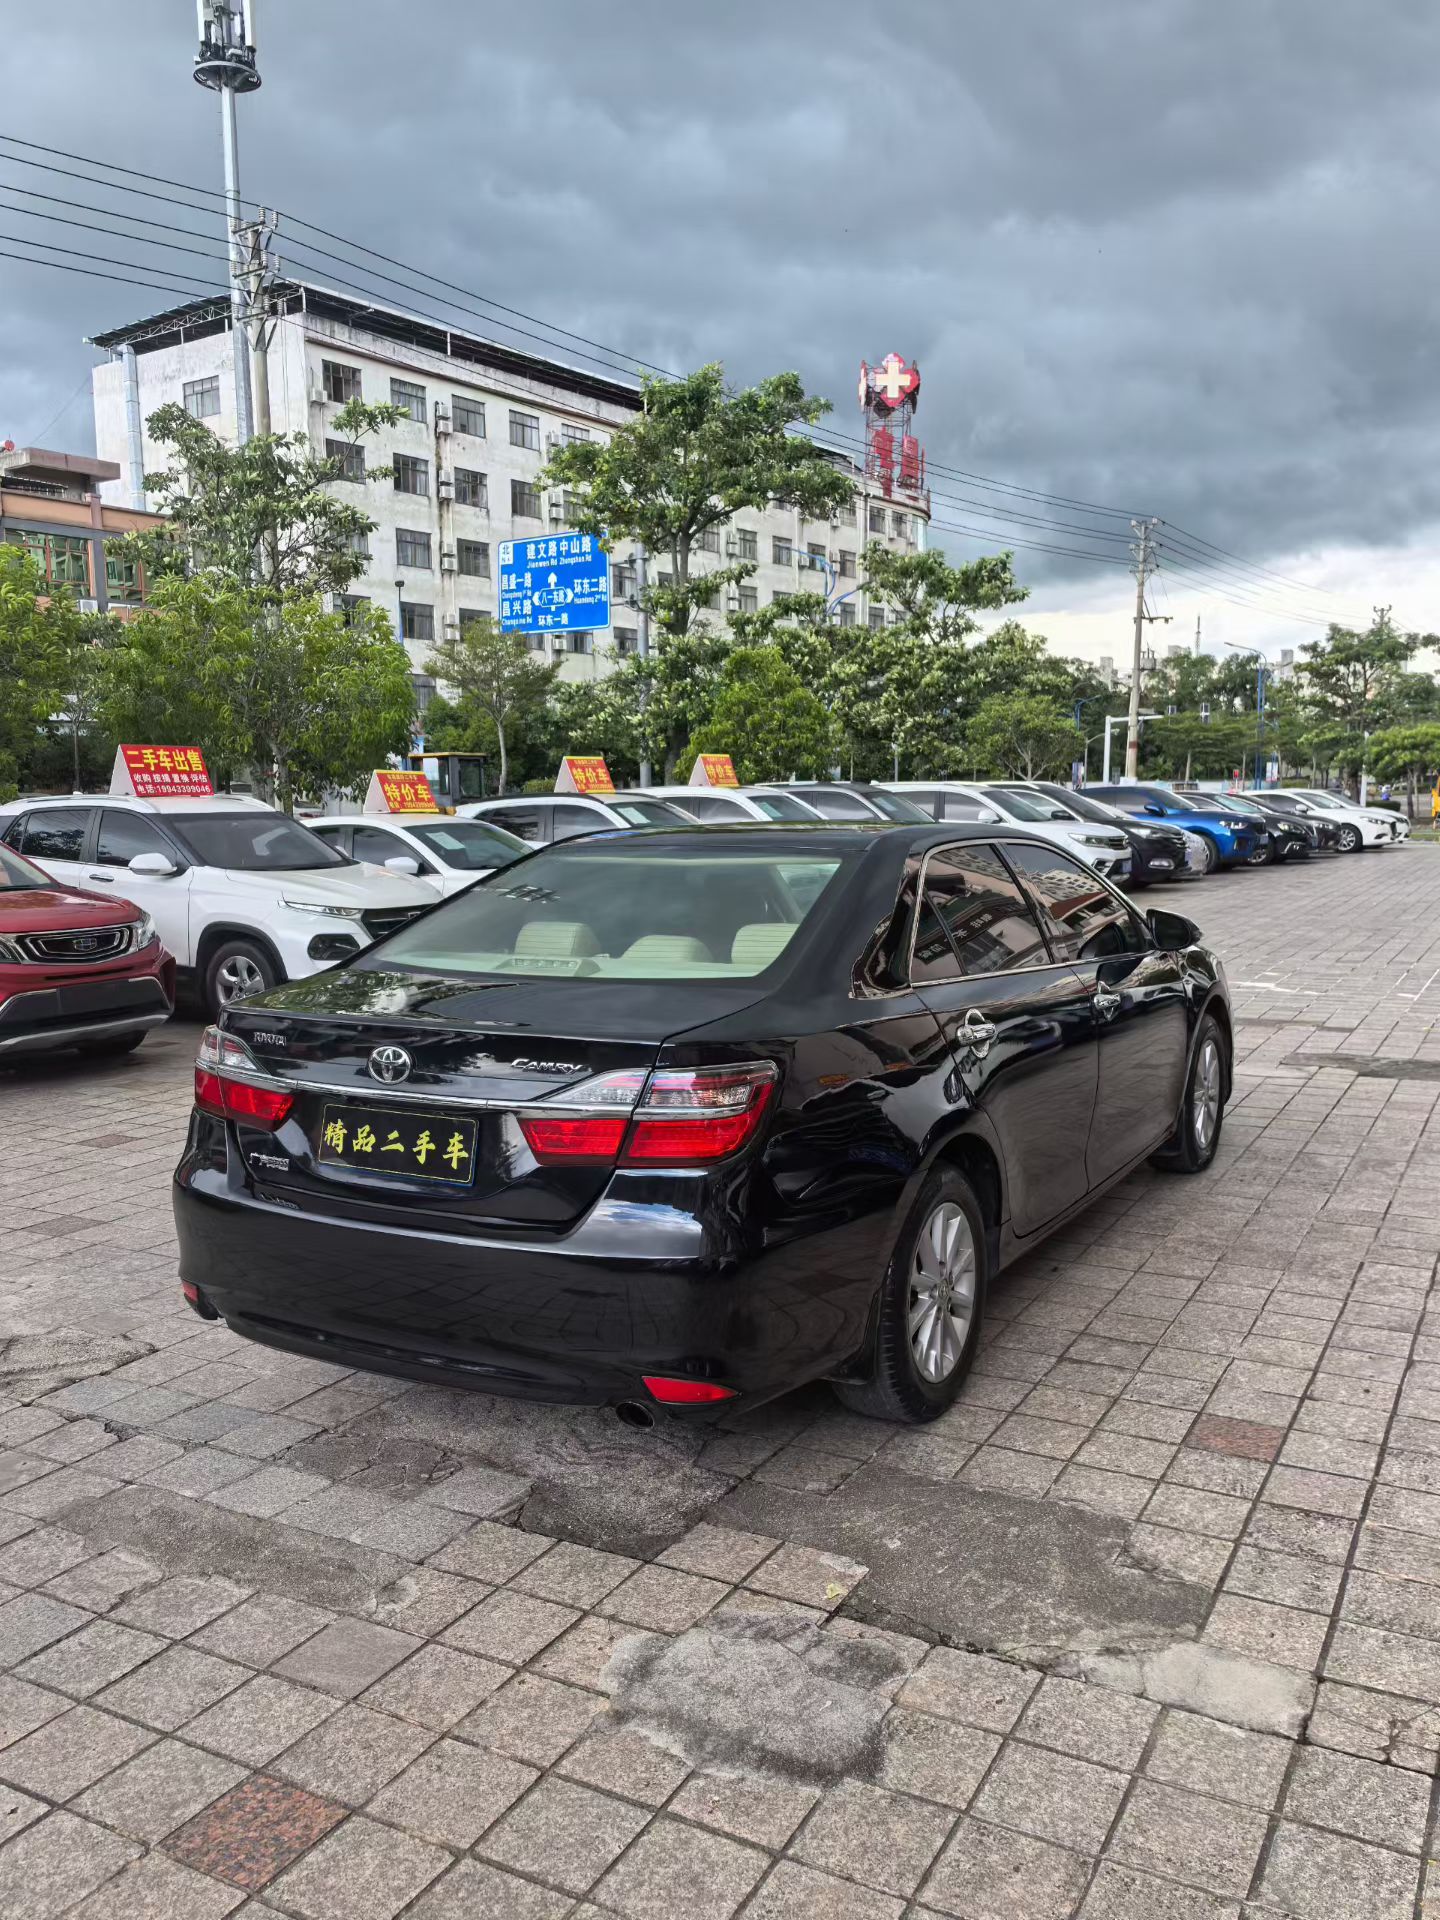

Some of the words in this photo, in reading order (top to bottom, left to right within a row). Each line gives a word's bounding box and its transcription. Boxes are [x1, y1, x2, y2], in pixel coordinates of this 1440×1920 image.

[574, 576, 607, 594] 环东二路
[503, 600, 532, 617] 昌兴路
[538, 613, 569, 626] 环东一路
[126, 748, 203, 771] 二手车出售
[133, 773, 152, 783] 收购
[190, 773, 208, 783] 评估
[571, 766, 609, 784] 特价车
[704, 763, 734, 779] 特价车
[384, 783, 431, 802] 特价车
[510, 1058, 584, 1075] CAMRY
[324, 1118, 470, 1170] 精品二手车
